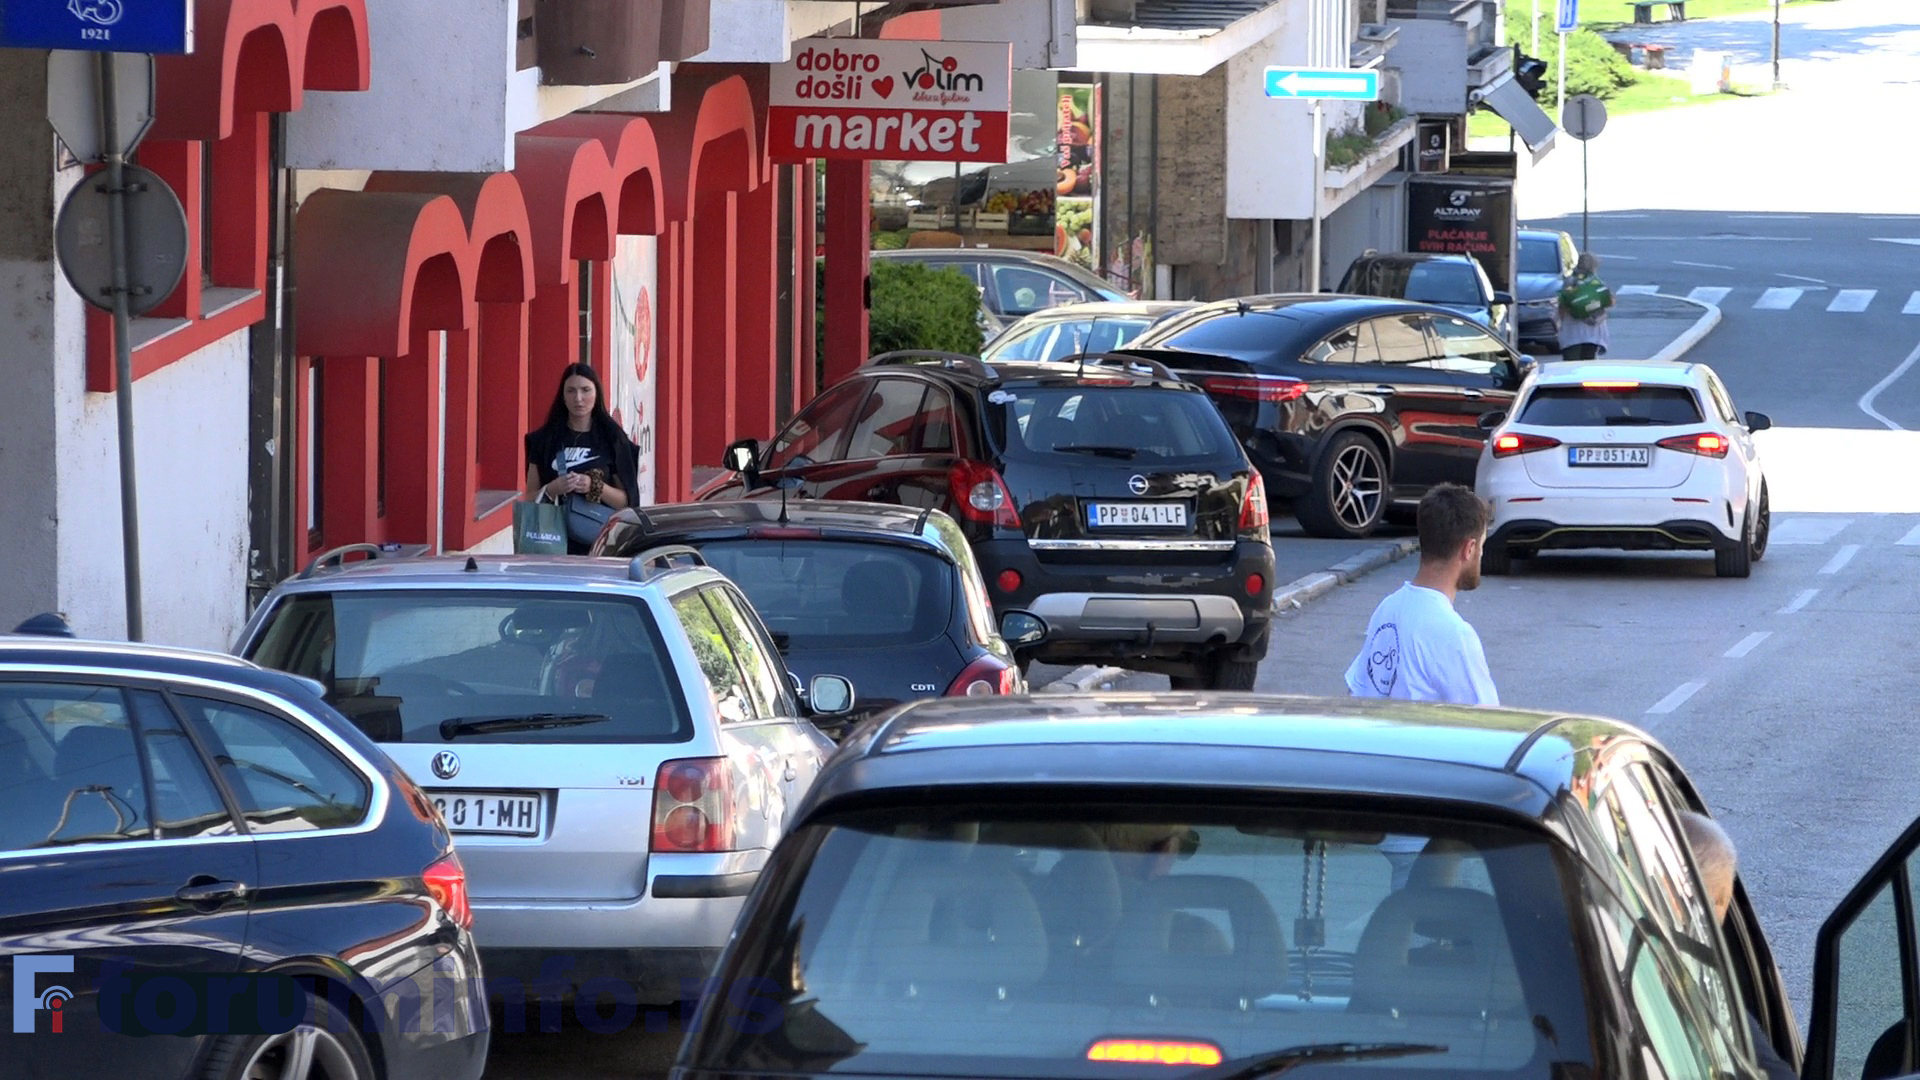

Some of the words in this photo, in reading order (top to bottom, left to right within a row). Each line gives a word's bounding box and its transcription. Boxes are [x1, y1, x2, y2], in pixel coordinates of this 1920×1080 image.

[80, 28, 110, 40] 1921
[796, 47, 880, 73] dobro
[902, 56, 984, 92] volim
[795, 74, 863, 100] došli
[794, 111, 982, 153] market
[1433, 207, 1482, 216] ALTAPAY
[564, 447, 592, 461] NIKE
[1578, 449, 1594, 461] PP
[1100, 506, 1118, 523] PP
[911, 683, 936, 691] CDTI
[616, 775, 645, 785] TDI
